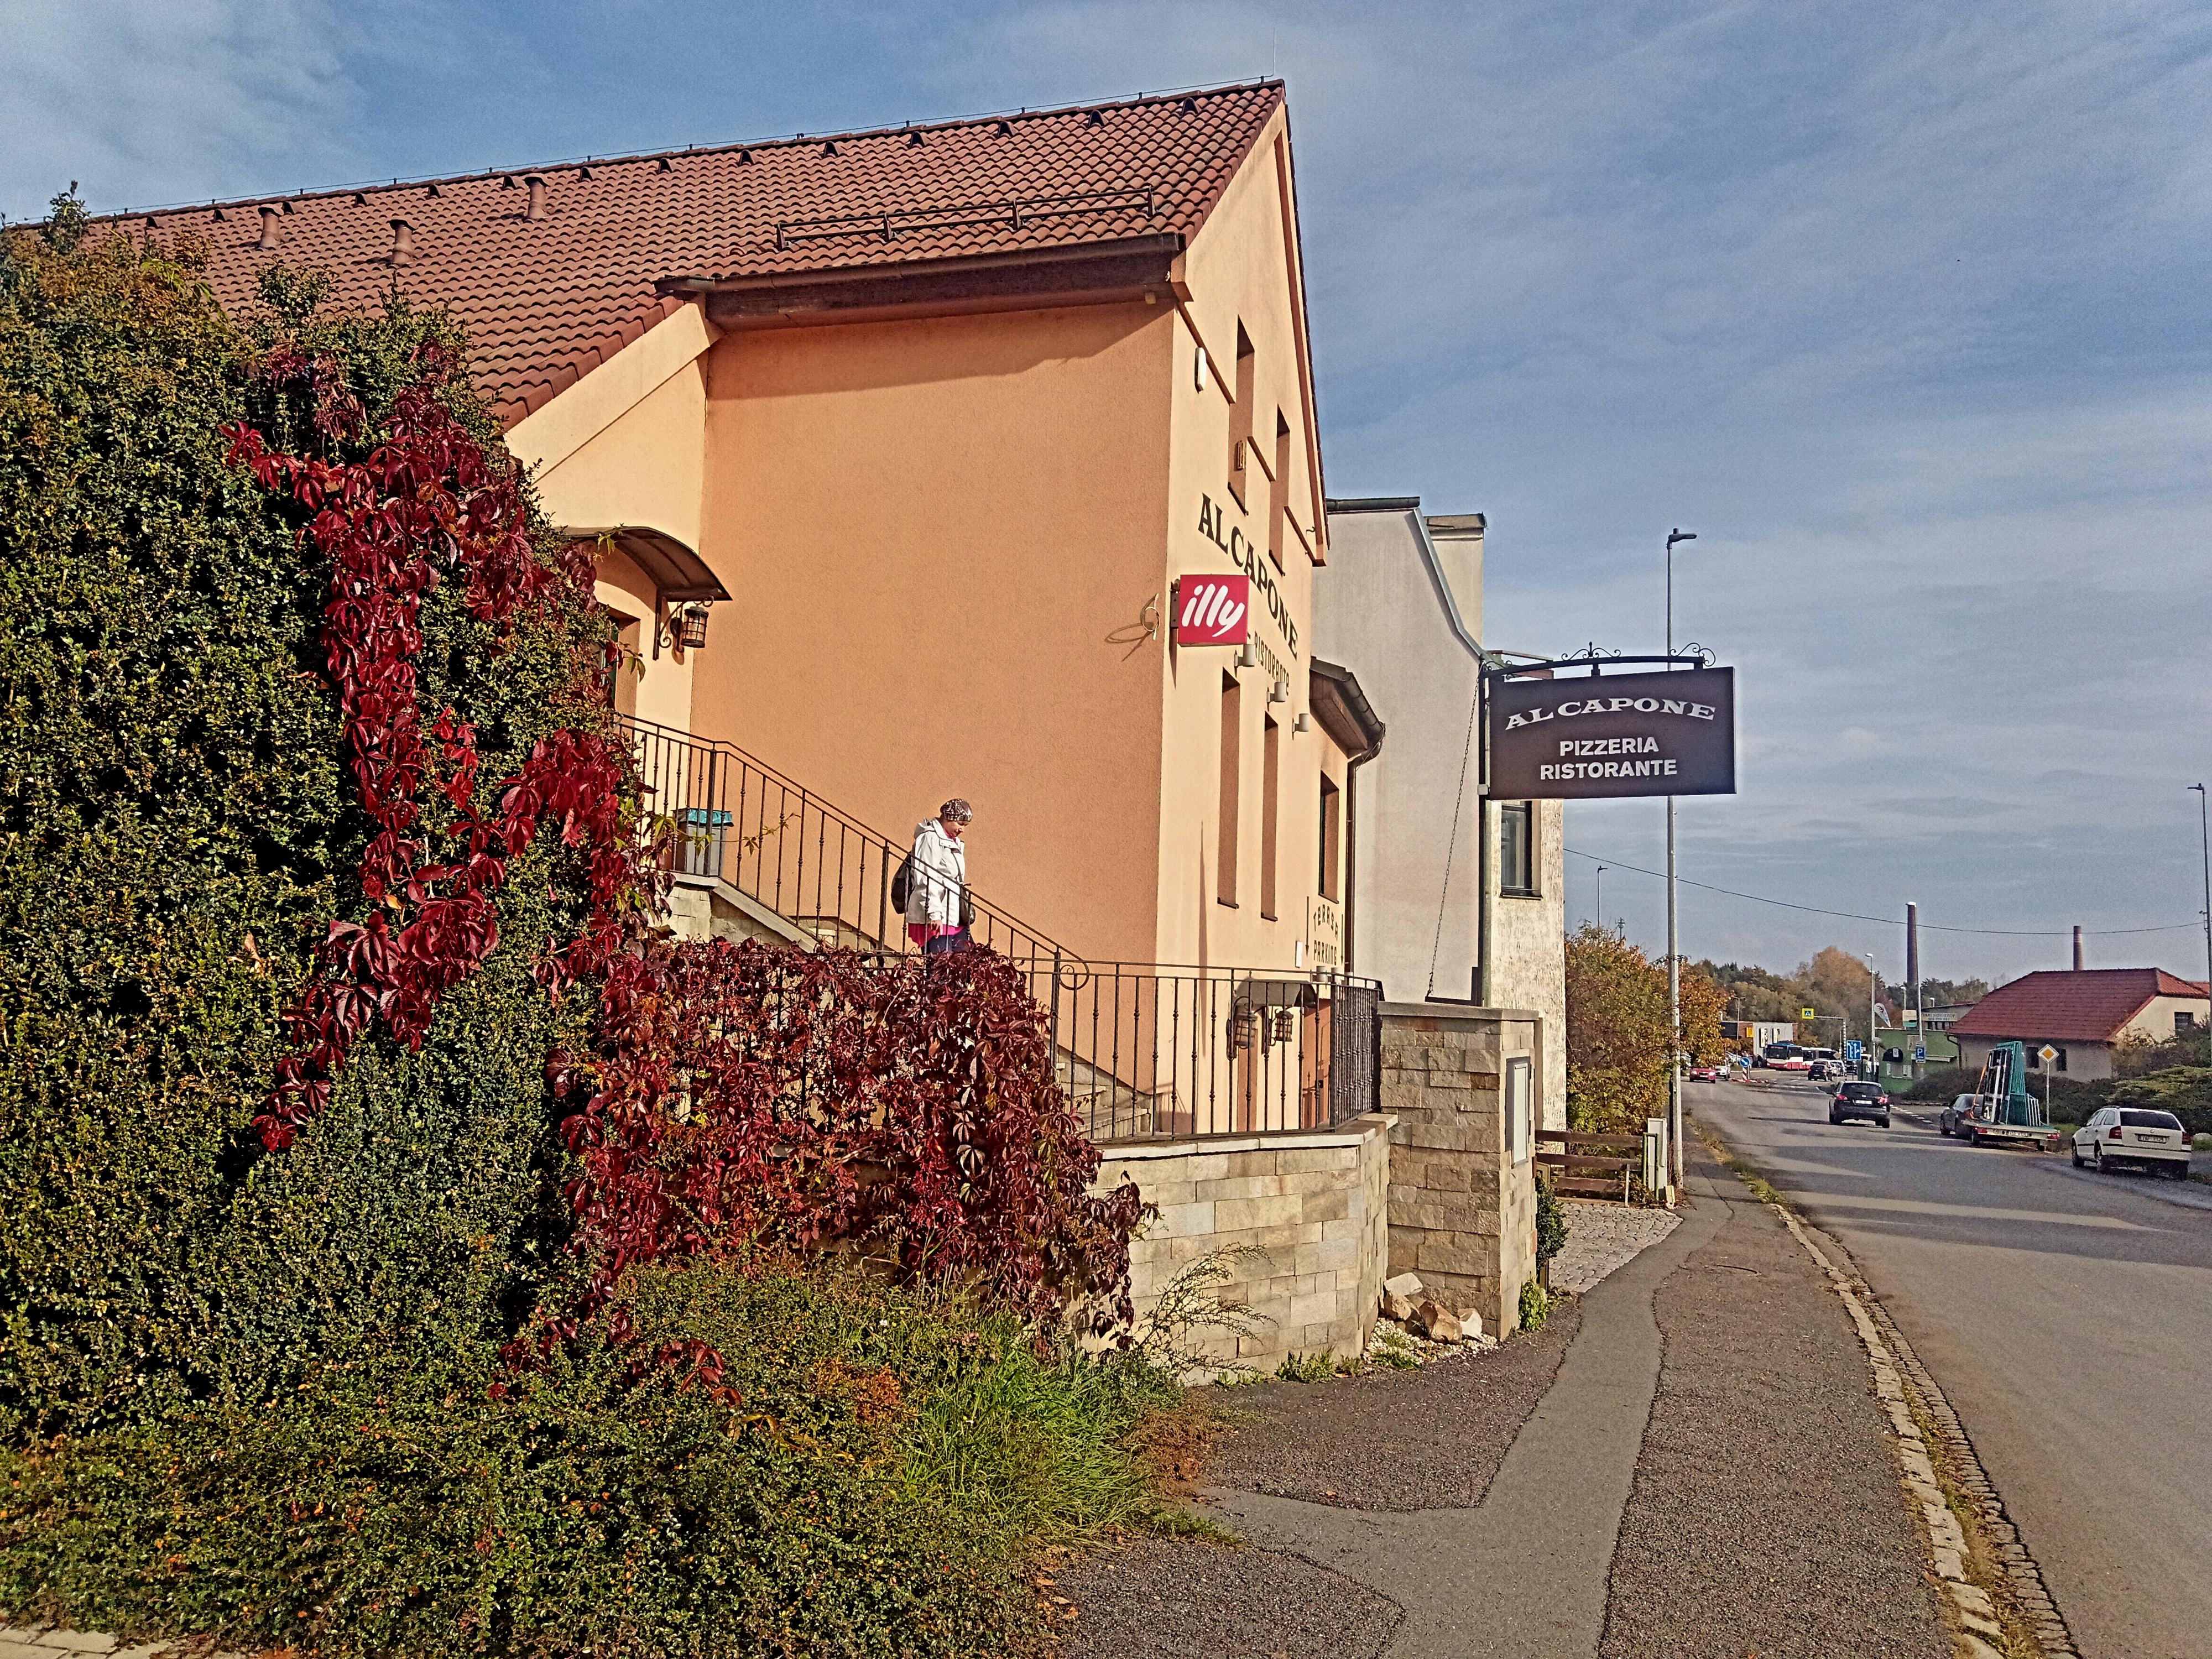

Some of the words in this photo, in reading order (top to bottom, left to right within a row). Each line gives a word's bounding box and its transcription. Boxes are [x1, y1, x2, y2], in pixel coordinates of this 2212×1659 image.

[1198, 492, 1228, 555] AL
[1231, 526, 1298, 661] CAPONE
[1182, 583, 1245, 637] illy
[1505, 708, 1554, 730] AL
[1558, 698, 1716, 720] CAPONE
[1560, 737, 1658, 756] PIZZERIA
[1541, 759, 1677, 780] RISTORANTE
